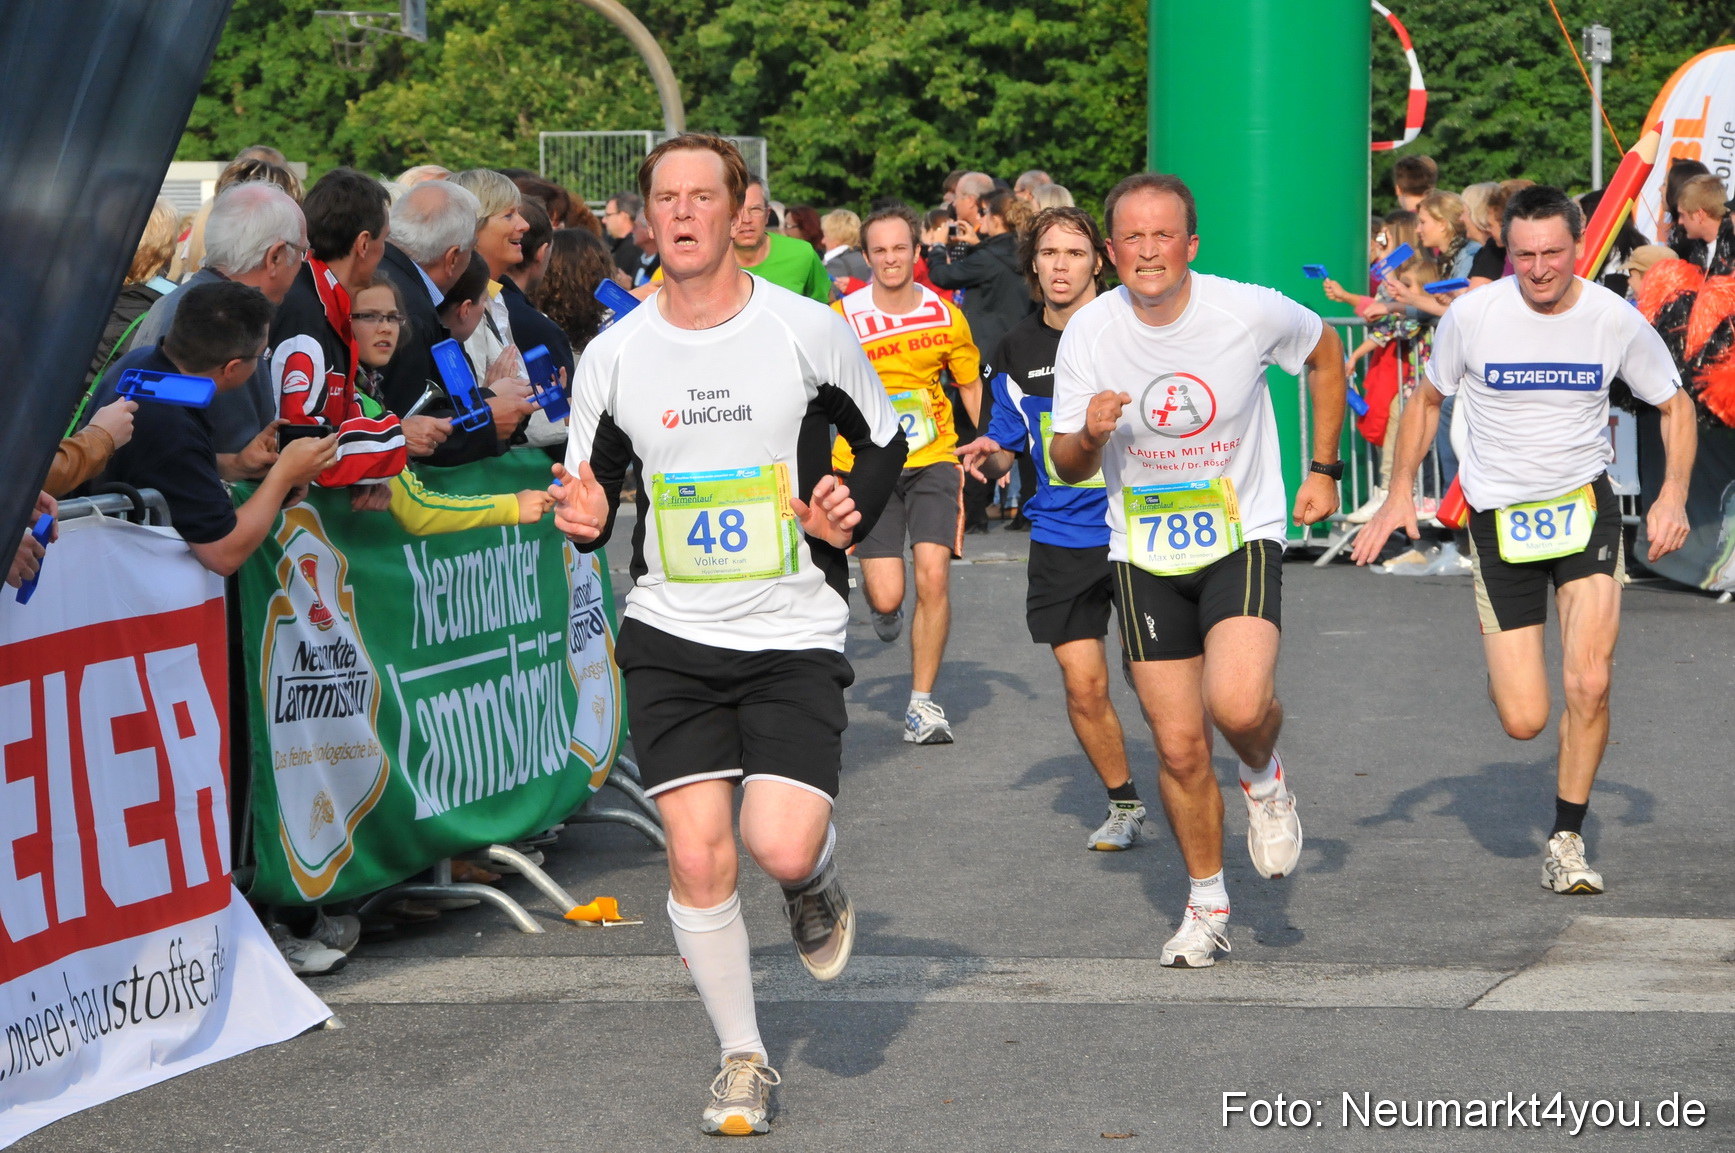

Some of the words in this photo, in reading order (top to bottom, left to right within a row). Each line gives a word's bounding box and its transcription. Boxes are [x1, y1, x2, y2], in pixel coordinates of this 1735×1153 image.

[866, 342, 902, 361] MAX
[908, 333, 953, 351] BÖGL
[1502, 370, 1596, 384] STAEDTLER
[687, 389, 730, 401] Team
[681, 404, 752, 425] UniCredit
[1128, 445, 1176, 459] LAUFEN
[1182, 446, 1205, 456] MIT
[1211, 437, 1240, 453] HERZ
[1156, 462, 1179, 470] Heck
[1188, 462, 1201, 470] Dr.
[671, 494, 713, 504] firmenlauf
[687, 508, 748, 554] 48
[1139, 511, 1217, 552] 788
[1510, 503, 1576, 541] 887
[694, 556, 729, 566] Volker
[1148, 553, 1167, 562] Max
[1170, 552, 1186, 560] von
[403, 525, 541, 649] Neumarkter
[385, 630, 571, 821] Lammsbräu
